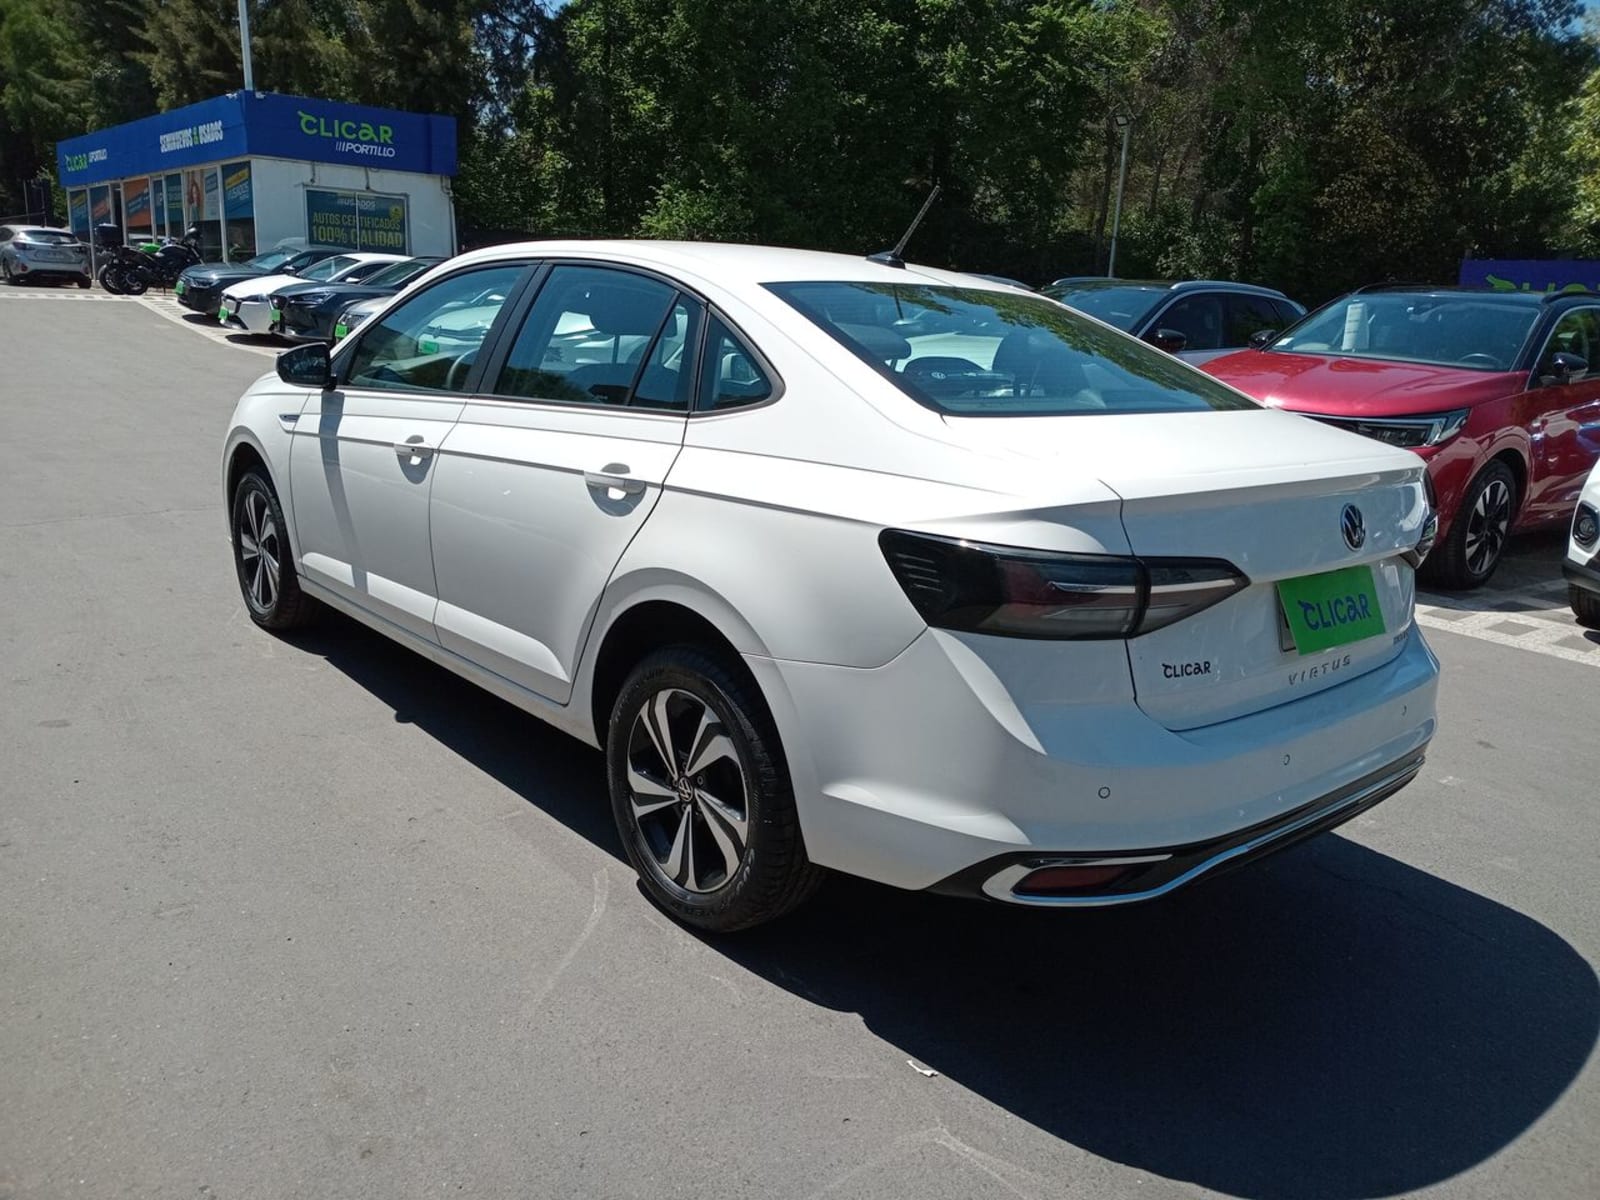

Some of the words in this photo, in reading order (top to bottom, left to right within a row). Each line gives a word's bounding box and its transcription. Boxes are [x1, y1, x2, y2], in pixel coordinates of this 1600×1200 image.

[313, 211, 341, 226] AUTOS
[312, 225, 347, 244] 100%
[350, 229, 403, 248] CALIDAD
[1287, 655, 1351, 686] VIRTUS
